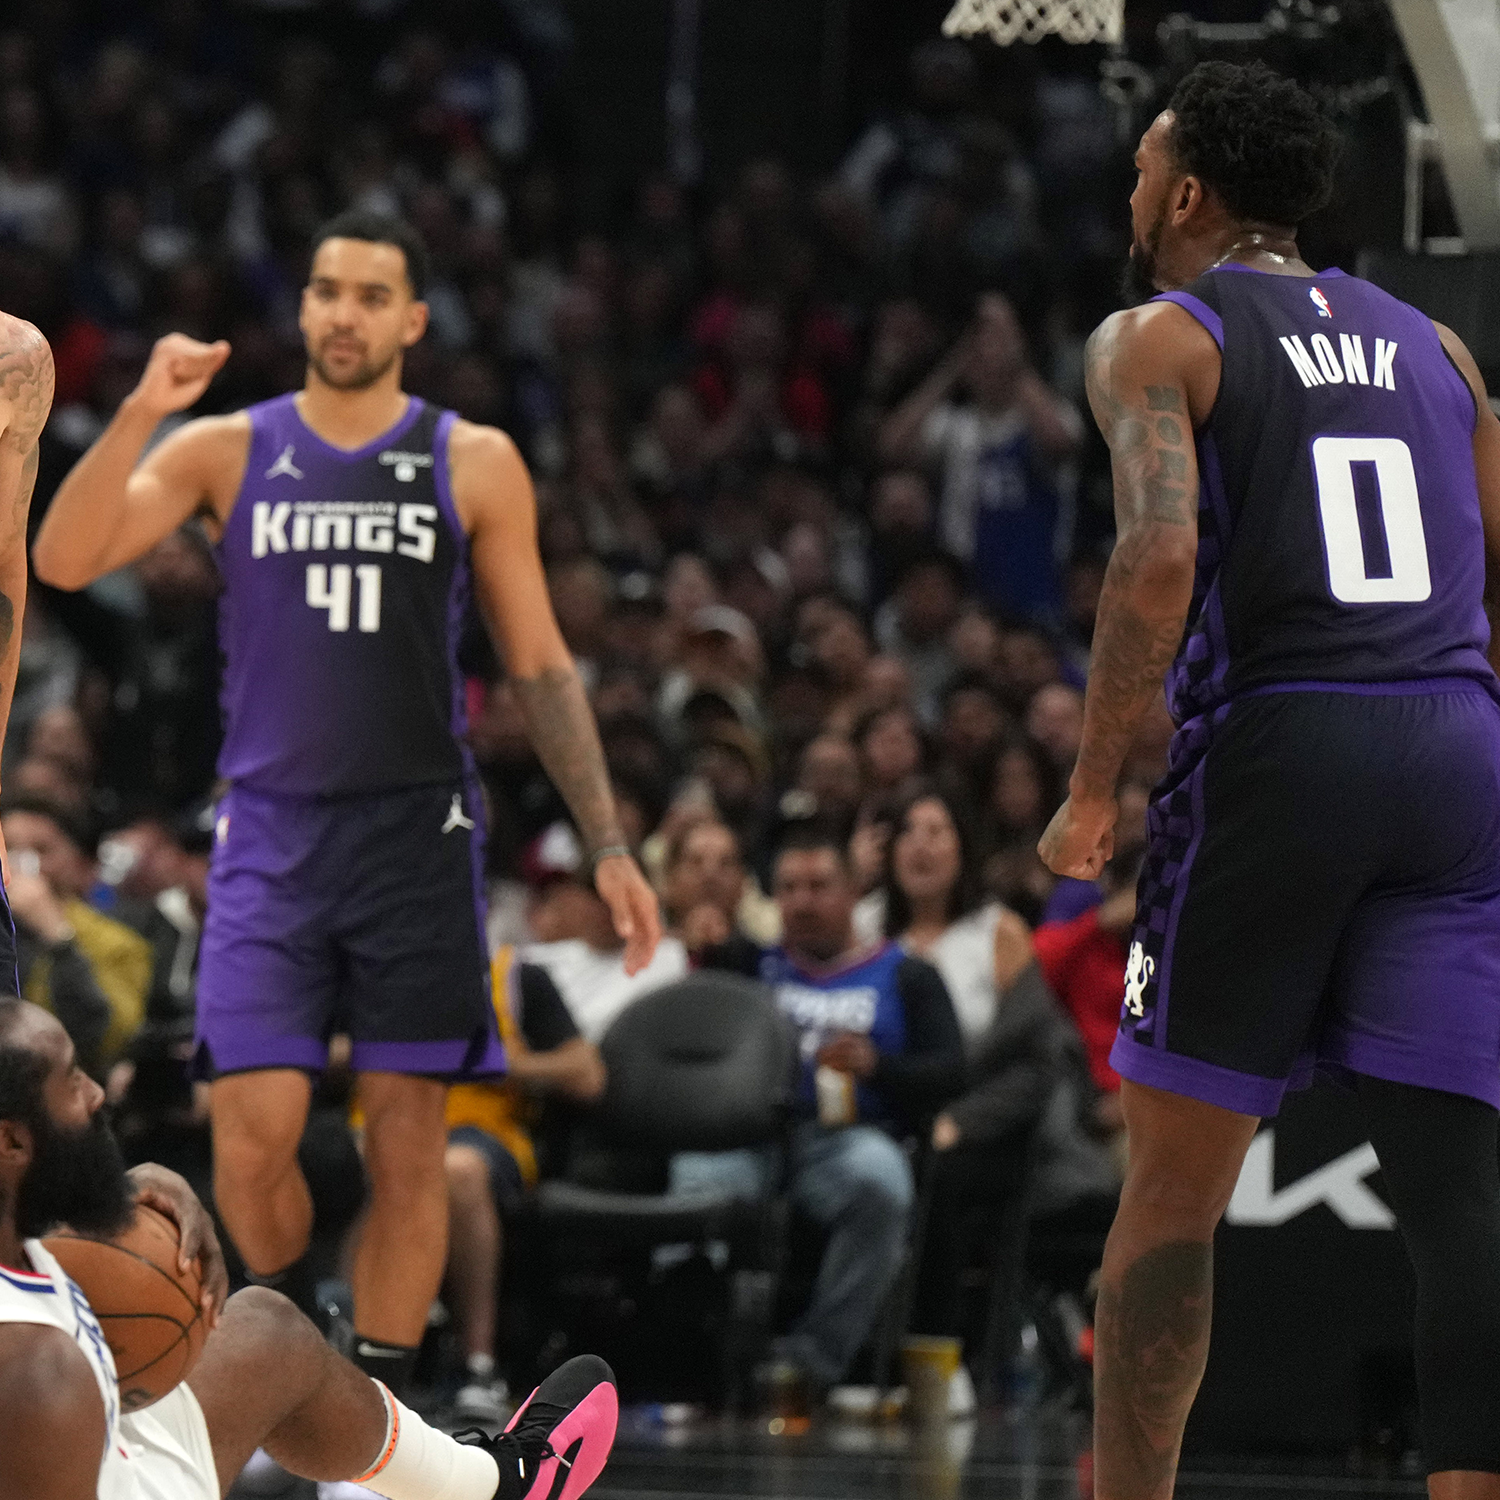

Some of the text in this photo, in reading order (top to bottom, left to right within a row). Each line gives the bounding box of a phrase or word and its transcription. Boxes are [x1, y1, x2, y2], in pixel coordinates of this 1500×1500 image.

[1278, 332, 1398, 391] MONK
[251, 501, 438, 564] KINGS
[1312, 436, 1432, 603] 0
[305, 563, 382, 633] 41
